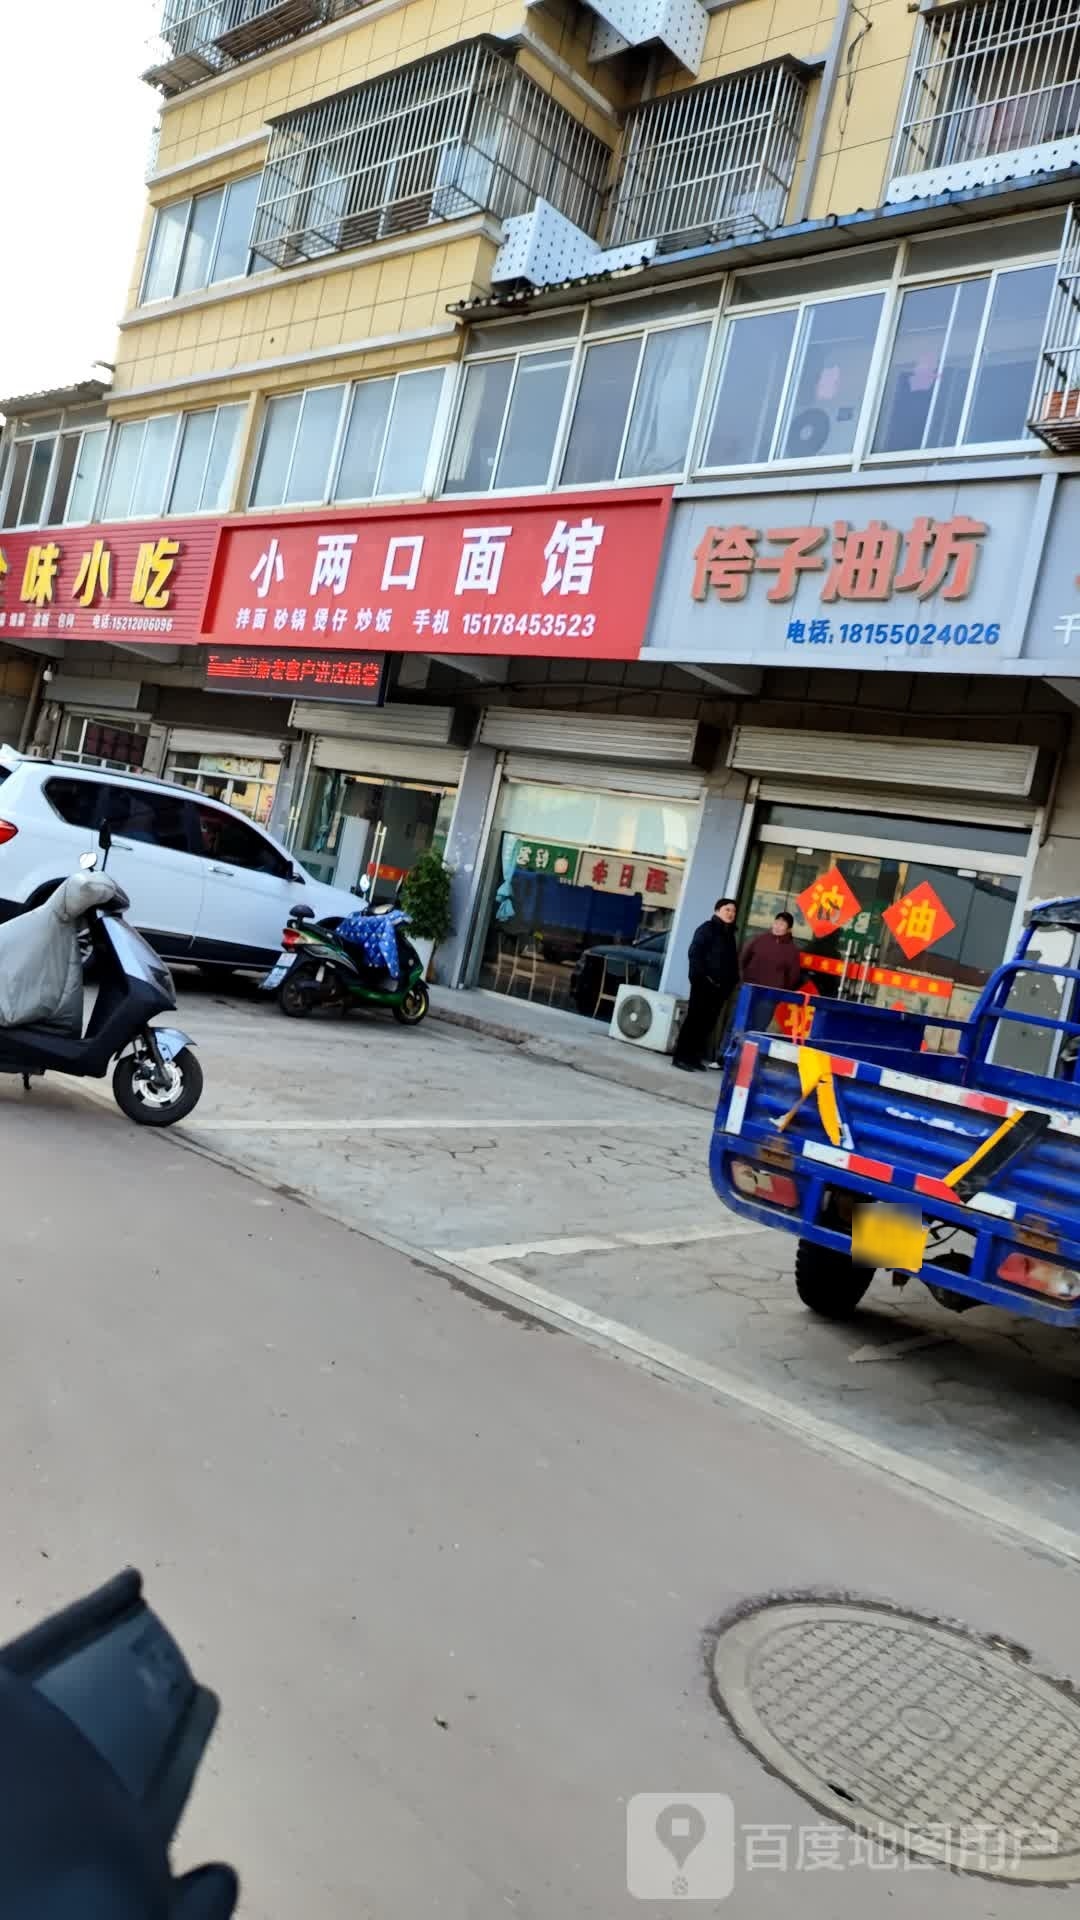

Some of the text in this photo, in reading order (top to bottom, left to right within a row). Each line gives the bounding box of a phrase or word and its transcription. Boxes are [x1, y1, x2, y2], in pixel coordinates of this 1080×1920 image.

[249, 517, 605, 598] 小两口面馆
[691, 516, 988, 602] 侉子油坊
[235, 607, 596, 637] 拌面 砂锅 煲仔 炒饭 手机 15178453523
[896, 898, 938, 942] 油
